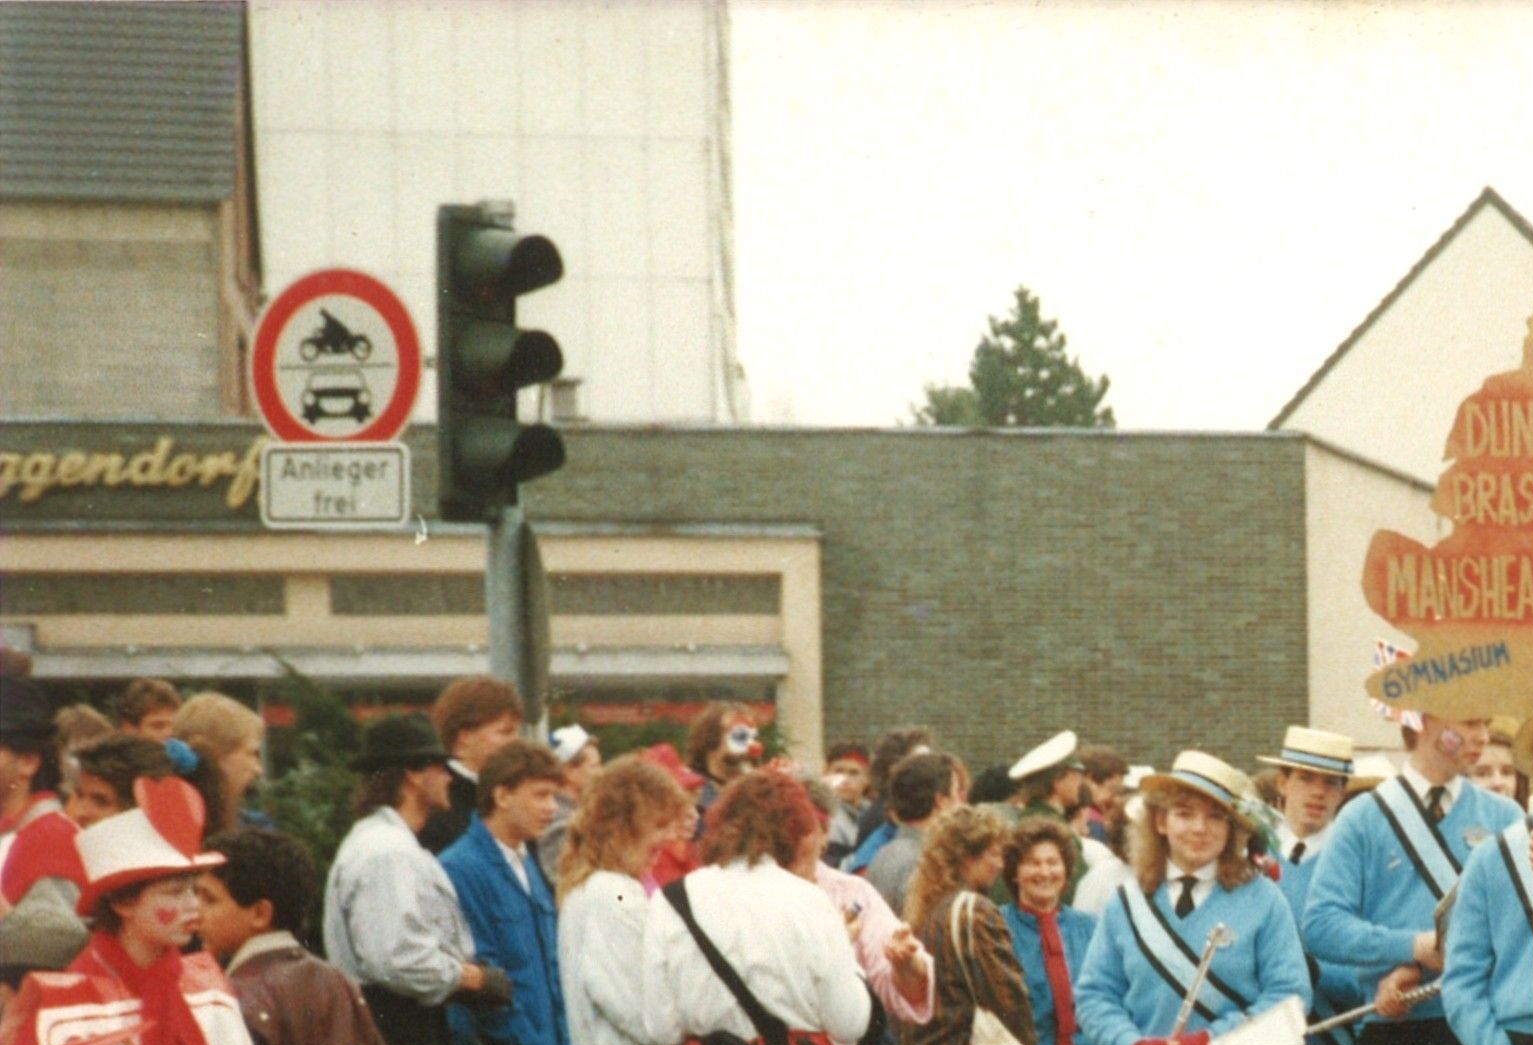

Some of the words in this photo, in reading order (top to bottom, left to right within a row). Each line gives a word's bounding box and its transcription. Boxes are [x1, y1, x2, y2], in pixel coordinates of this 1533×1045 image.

[281, 456, 390, 486] Anlieger
[313, 489, 357, 514] frei
[1382, 640, 1511, 699] GYMNASIUM
